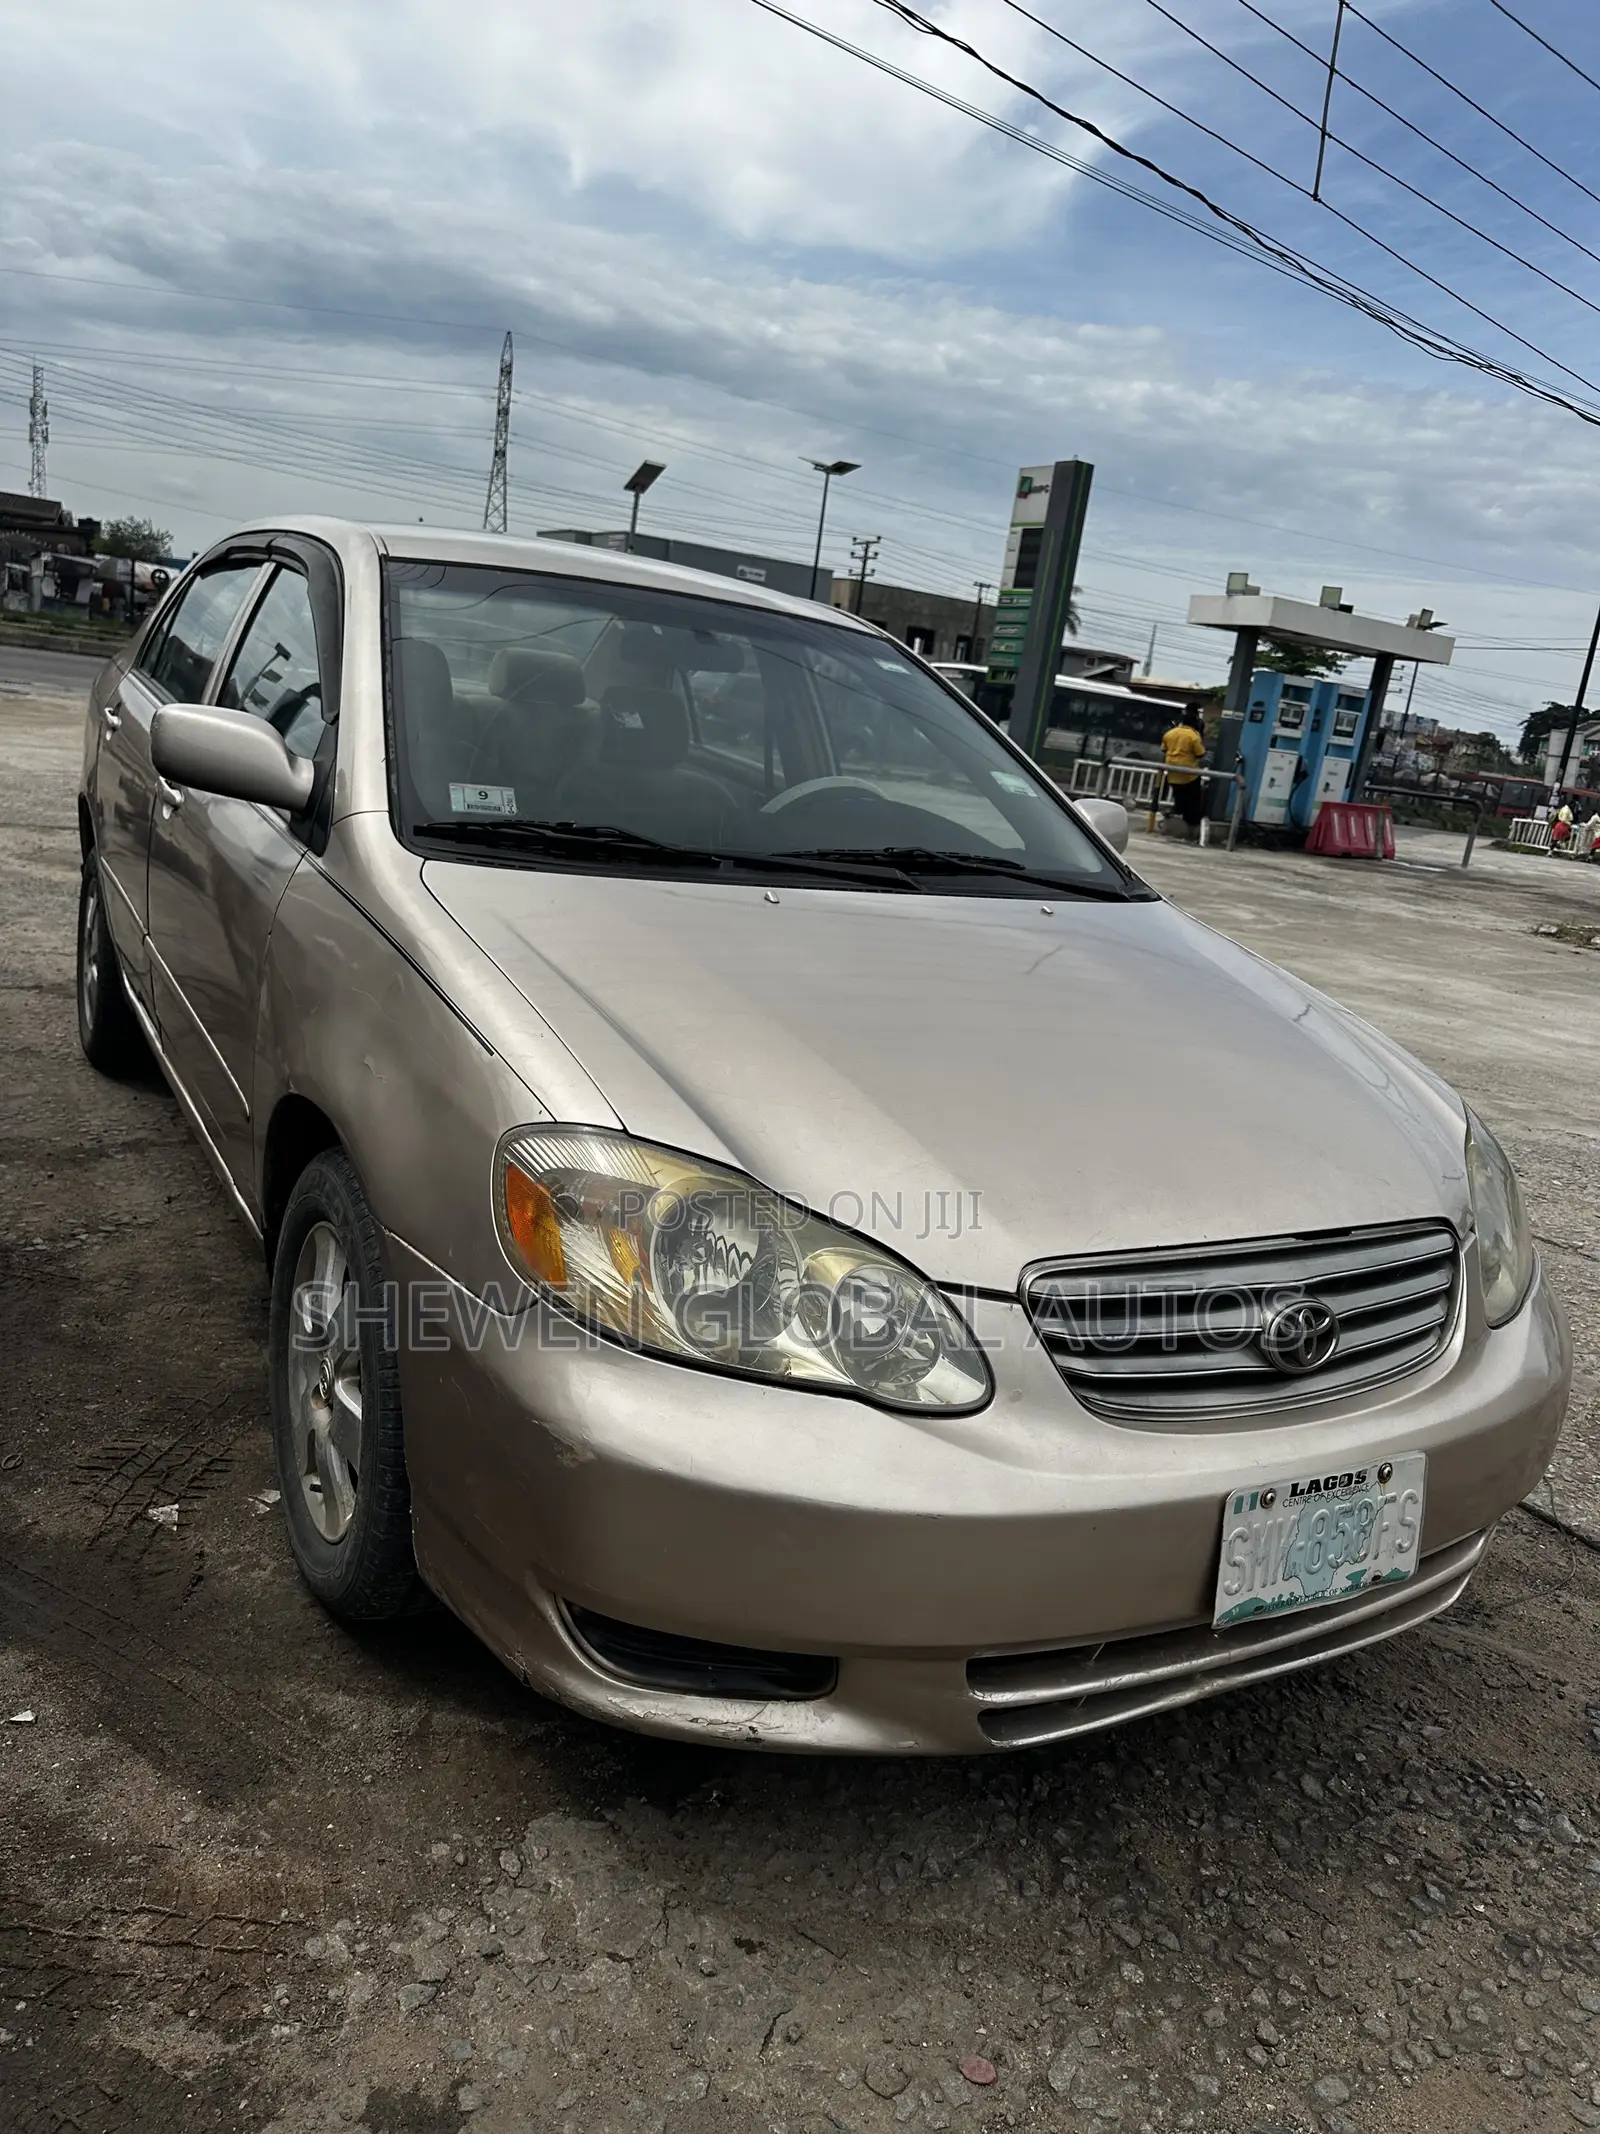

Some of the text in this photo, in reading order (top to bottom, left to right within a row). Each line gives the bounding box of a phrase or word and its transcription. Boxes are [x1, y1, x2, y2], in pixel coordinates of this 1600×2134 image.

[477, 790, 489, 801] 9
[1282, 1482, 1370, 1508] CENTRE OF EXCELLENCE
[1289, 1469, 1368, 1498] LAGOS
